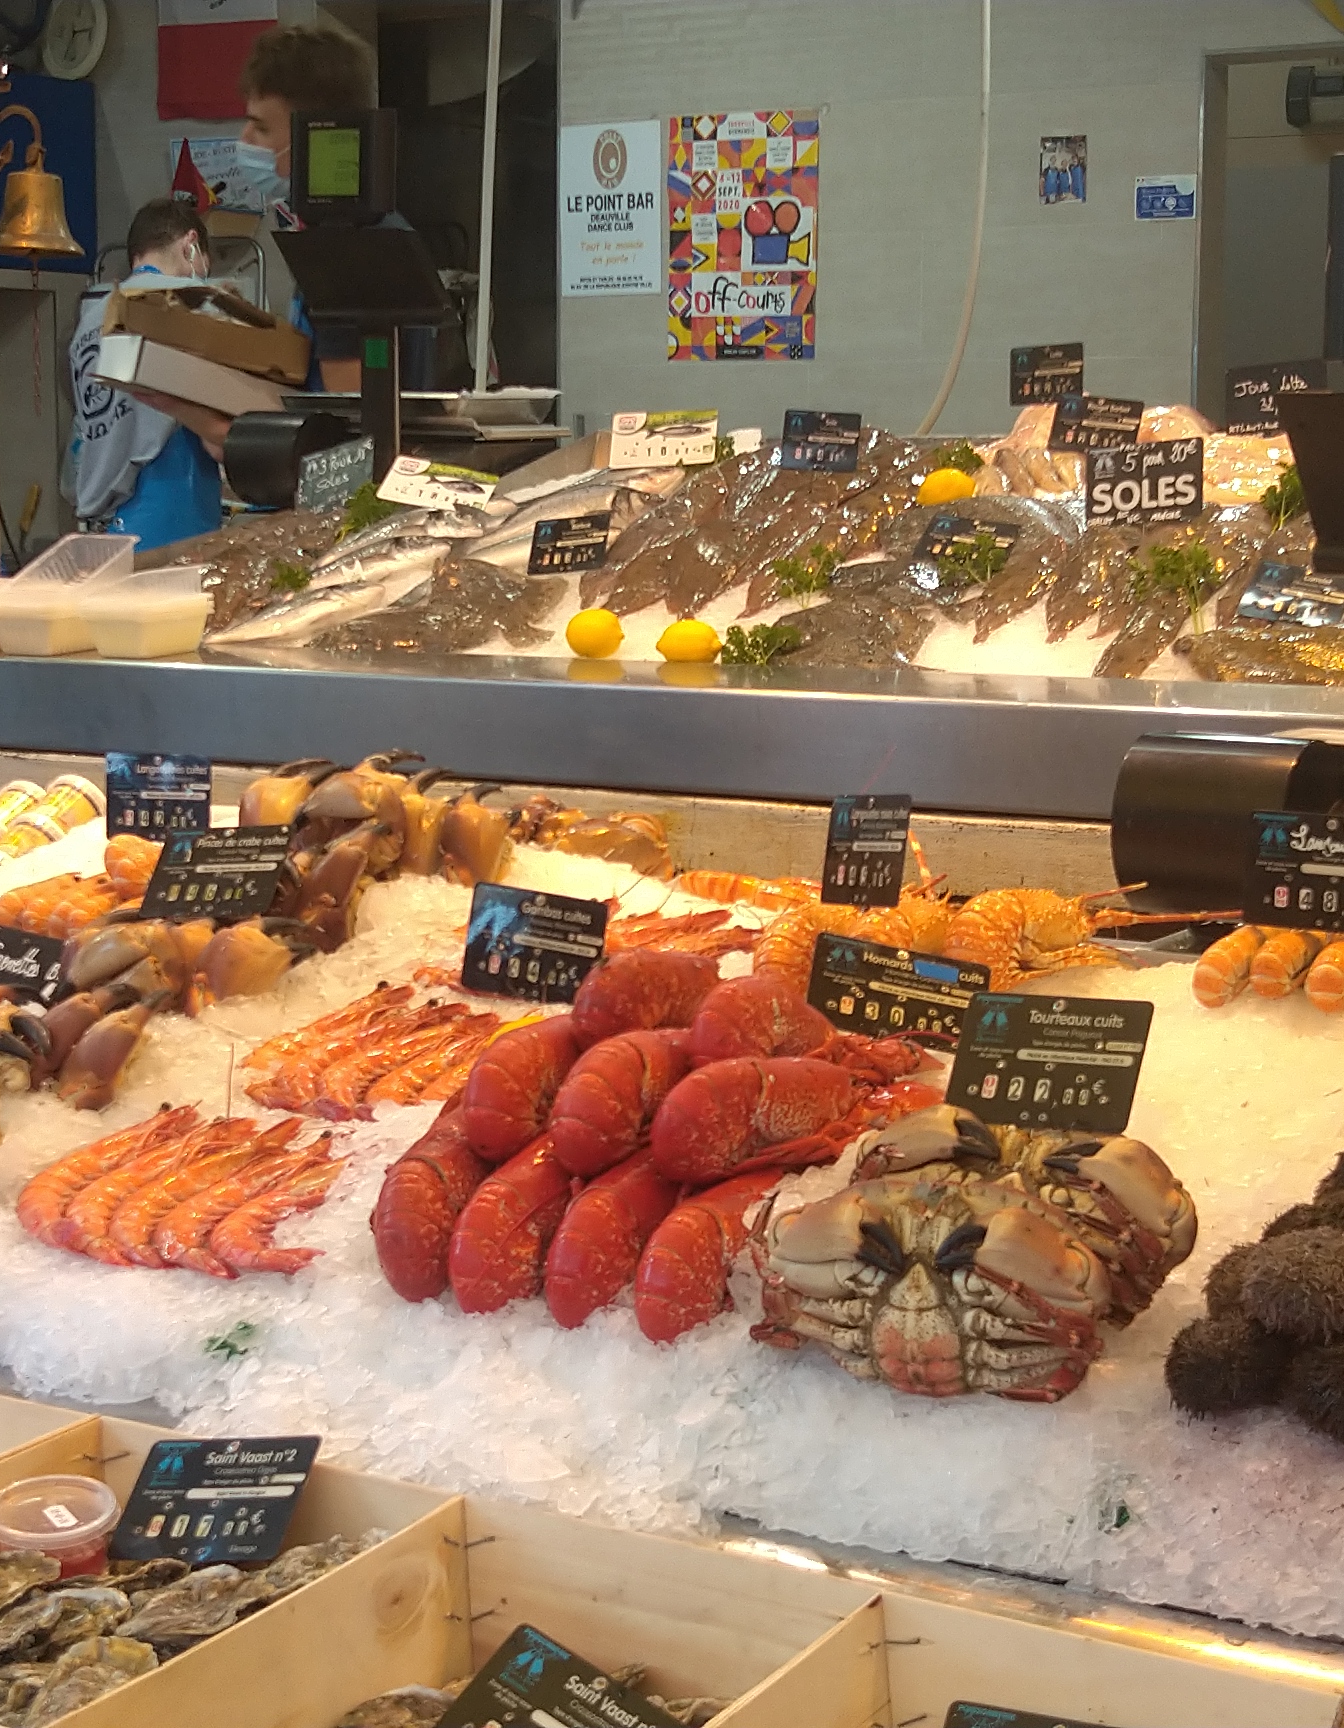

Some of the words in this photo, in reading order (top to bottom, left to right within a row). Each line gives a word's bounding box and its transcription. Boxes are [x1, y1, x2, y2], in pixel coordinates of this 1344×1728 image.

[567, 195, 583, 213] LE
[586, 193, 624, 213] POINT
[627, 192, 654, 210] BAR
[718, 200, 740, 210] 2020
[1091, 473, 1197, 515] SOLES
[863, 951, 914, 971] Homards
[959, 971, 985, 985] cuits
[1029, 1009, 1092, 1027] Tourteaux
[1094, 1015, 1125, 1029] cuits
[205, 1450, 238, 1466] Saint
[240, 1449, 273, 1464] Vaast
[274, 1448, 298, 1463] n°2
[564, 1675, 603, 1706] Saint
